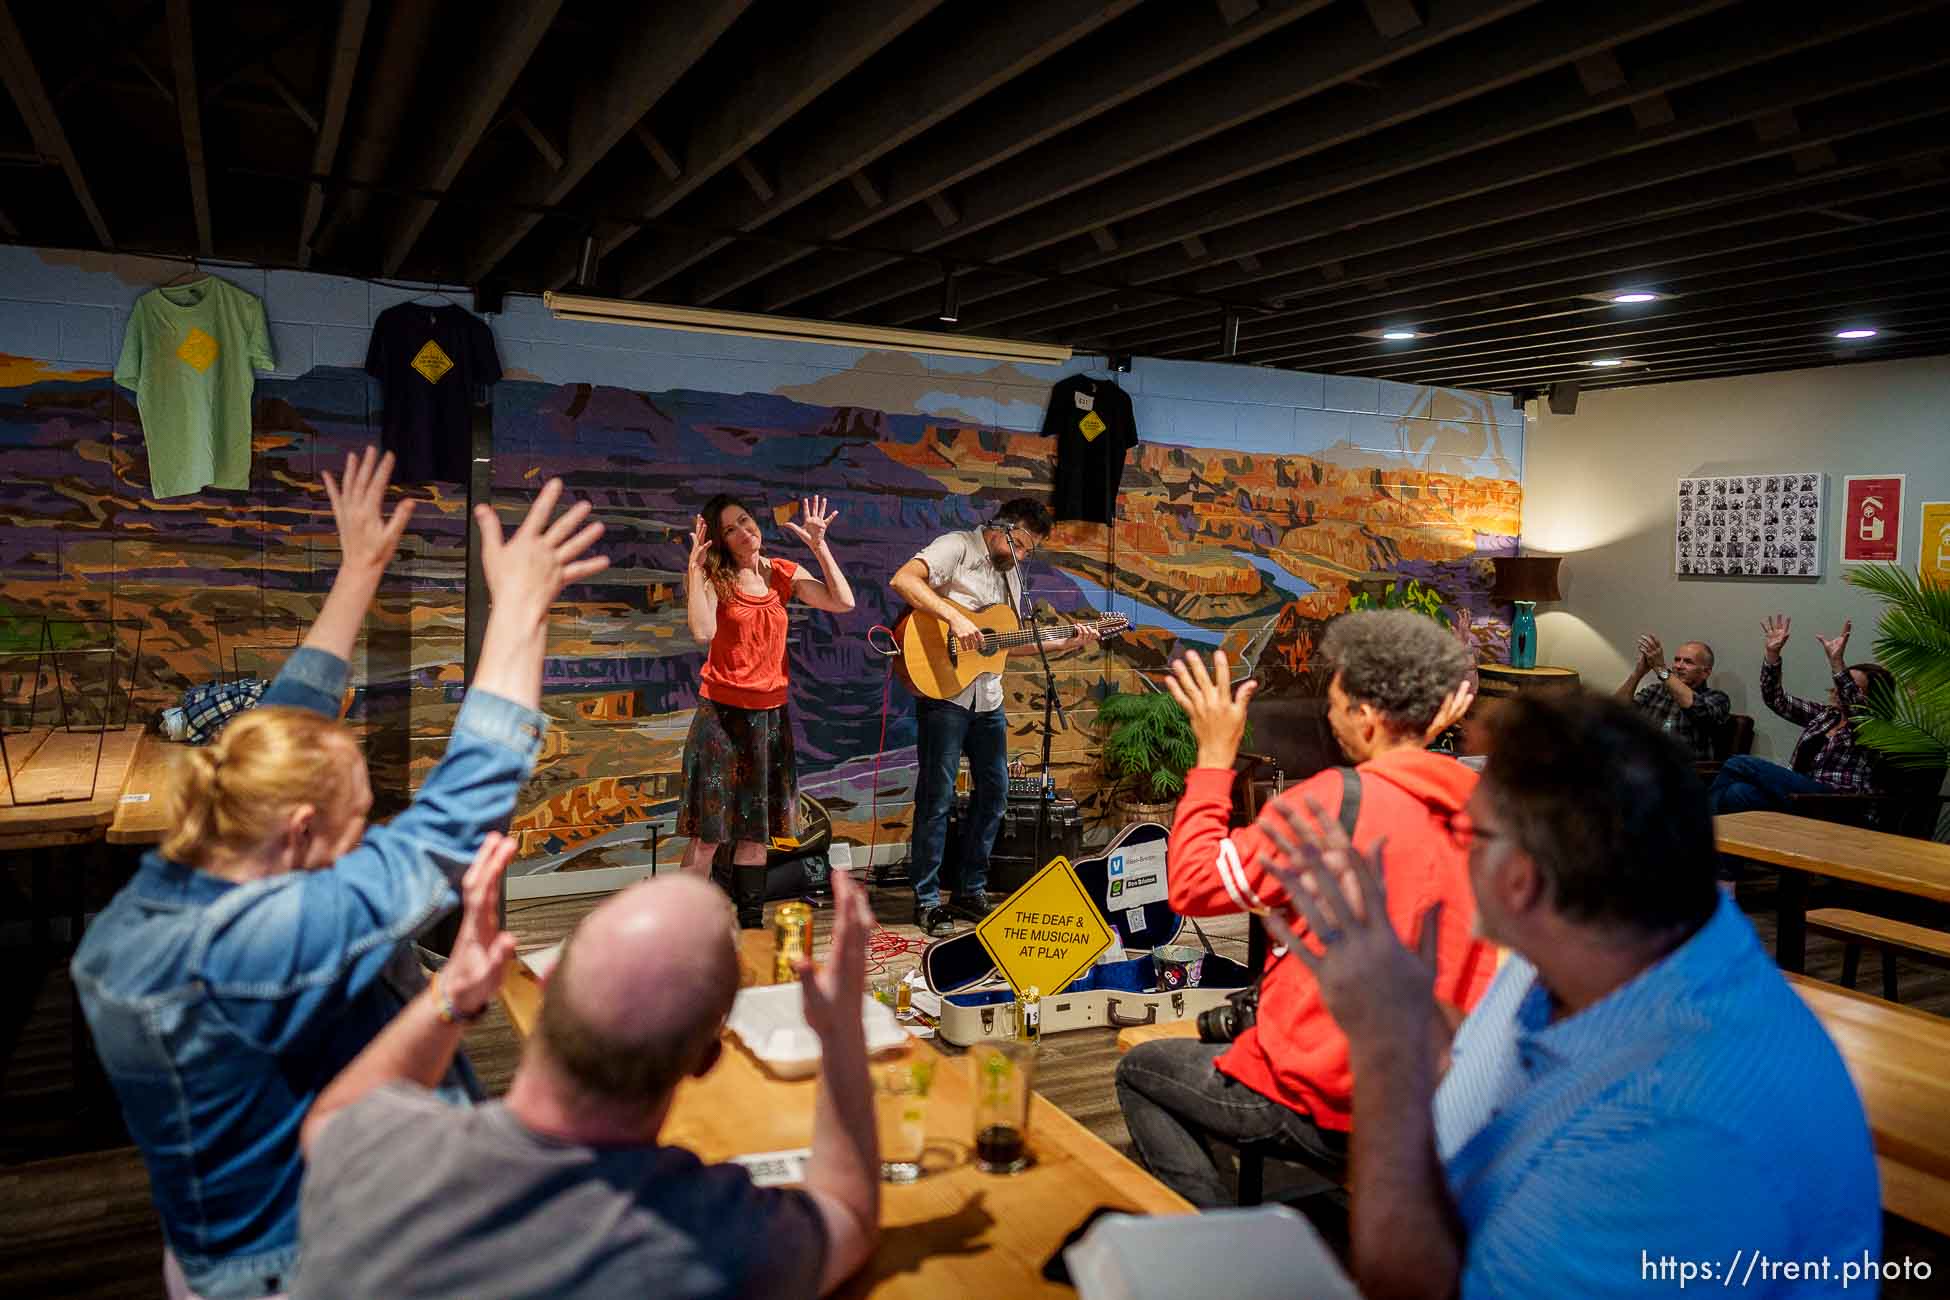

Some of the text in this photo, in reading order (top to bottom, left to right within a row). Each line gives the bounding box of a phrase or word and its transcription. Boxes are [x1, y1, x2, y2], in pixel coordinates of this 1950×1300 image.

[1015, 911, 1084, 928] THE DEAF &
[1003, 927, 1089, 945] THE MUSICIAN
[1018, 945, 1068, 960] AT PLAY
